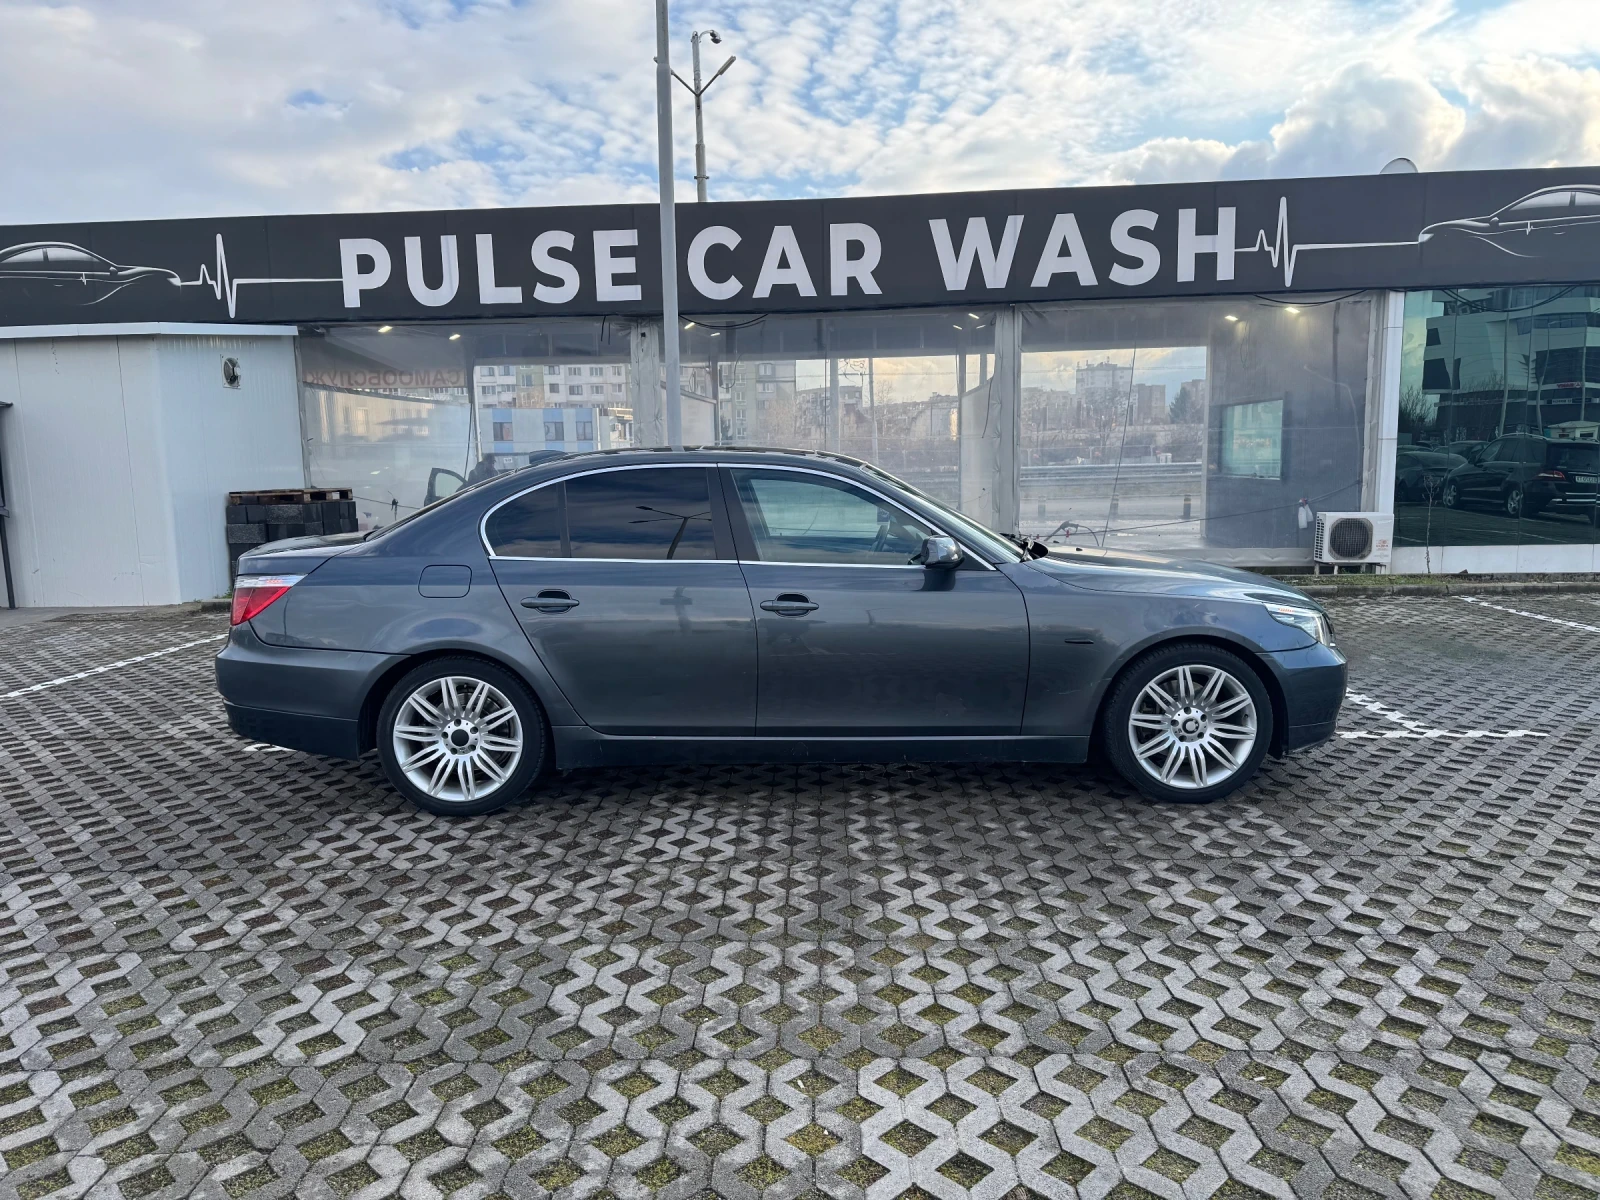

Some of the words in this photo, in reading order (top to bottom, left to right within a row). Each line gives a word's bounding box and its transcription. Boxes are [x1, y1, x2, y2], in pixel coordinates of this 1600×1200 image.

[339, 228, 642, 308] PULSE
[687, 222, 882, 300] CAR
[928, 206, 1237, 291] WASH
